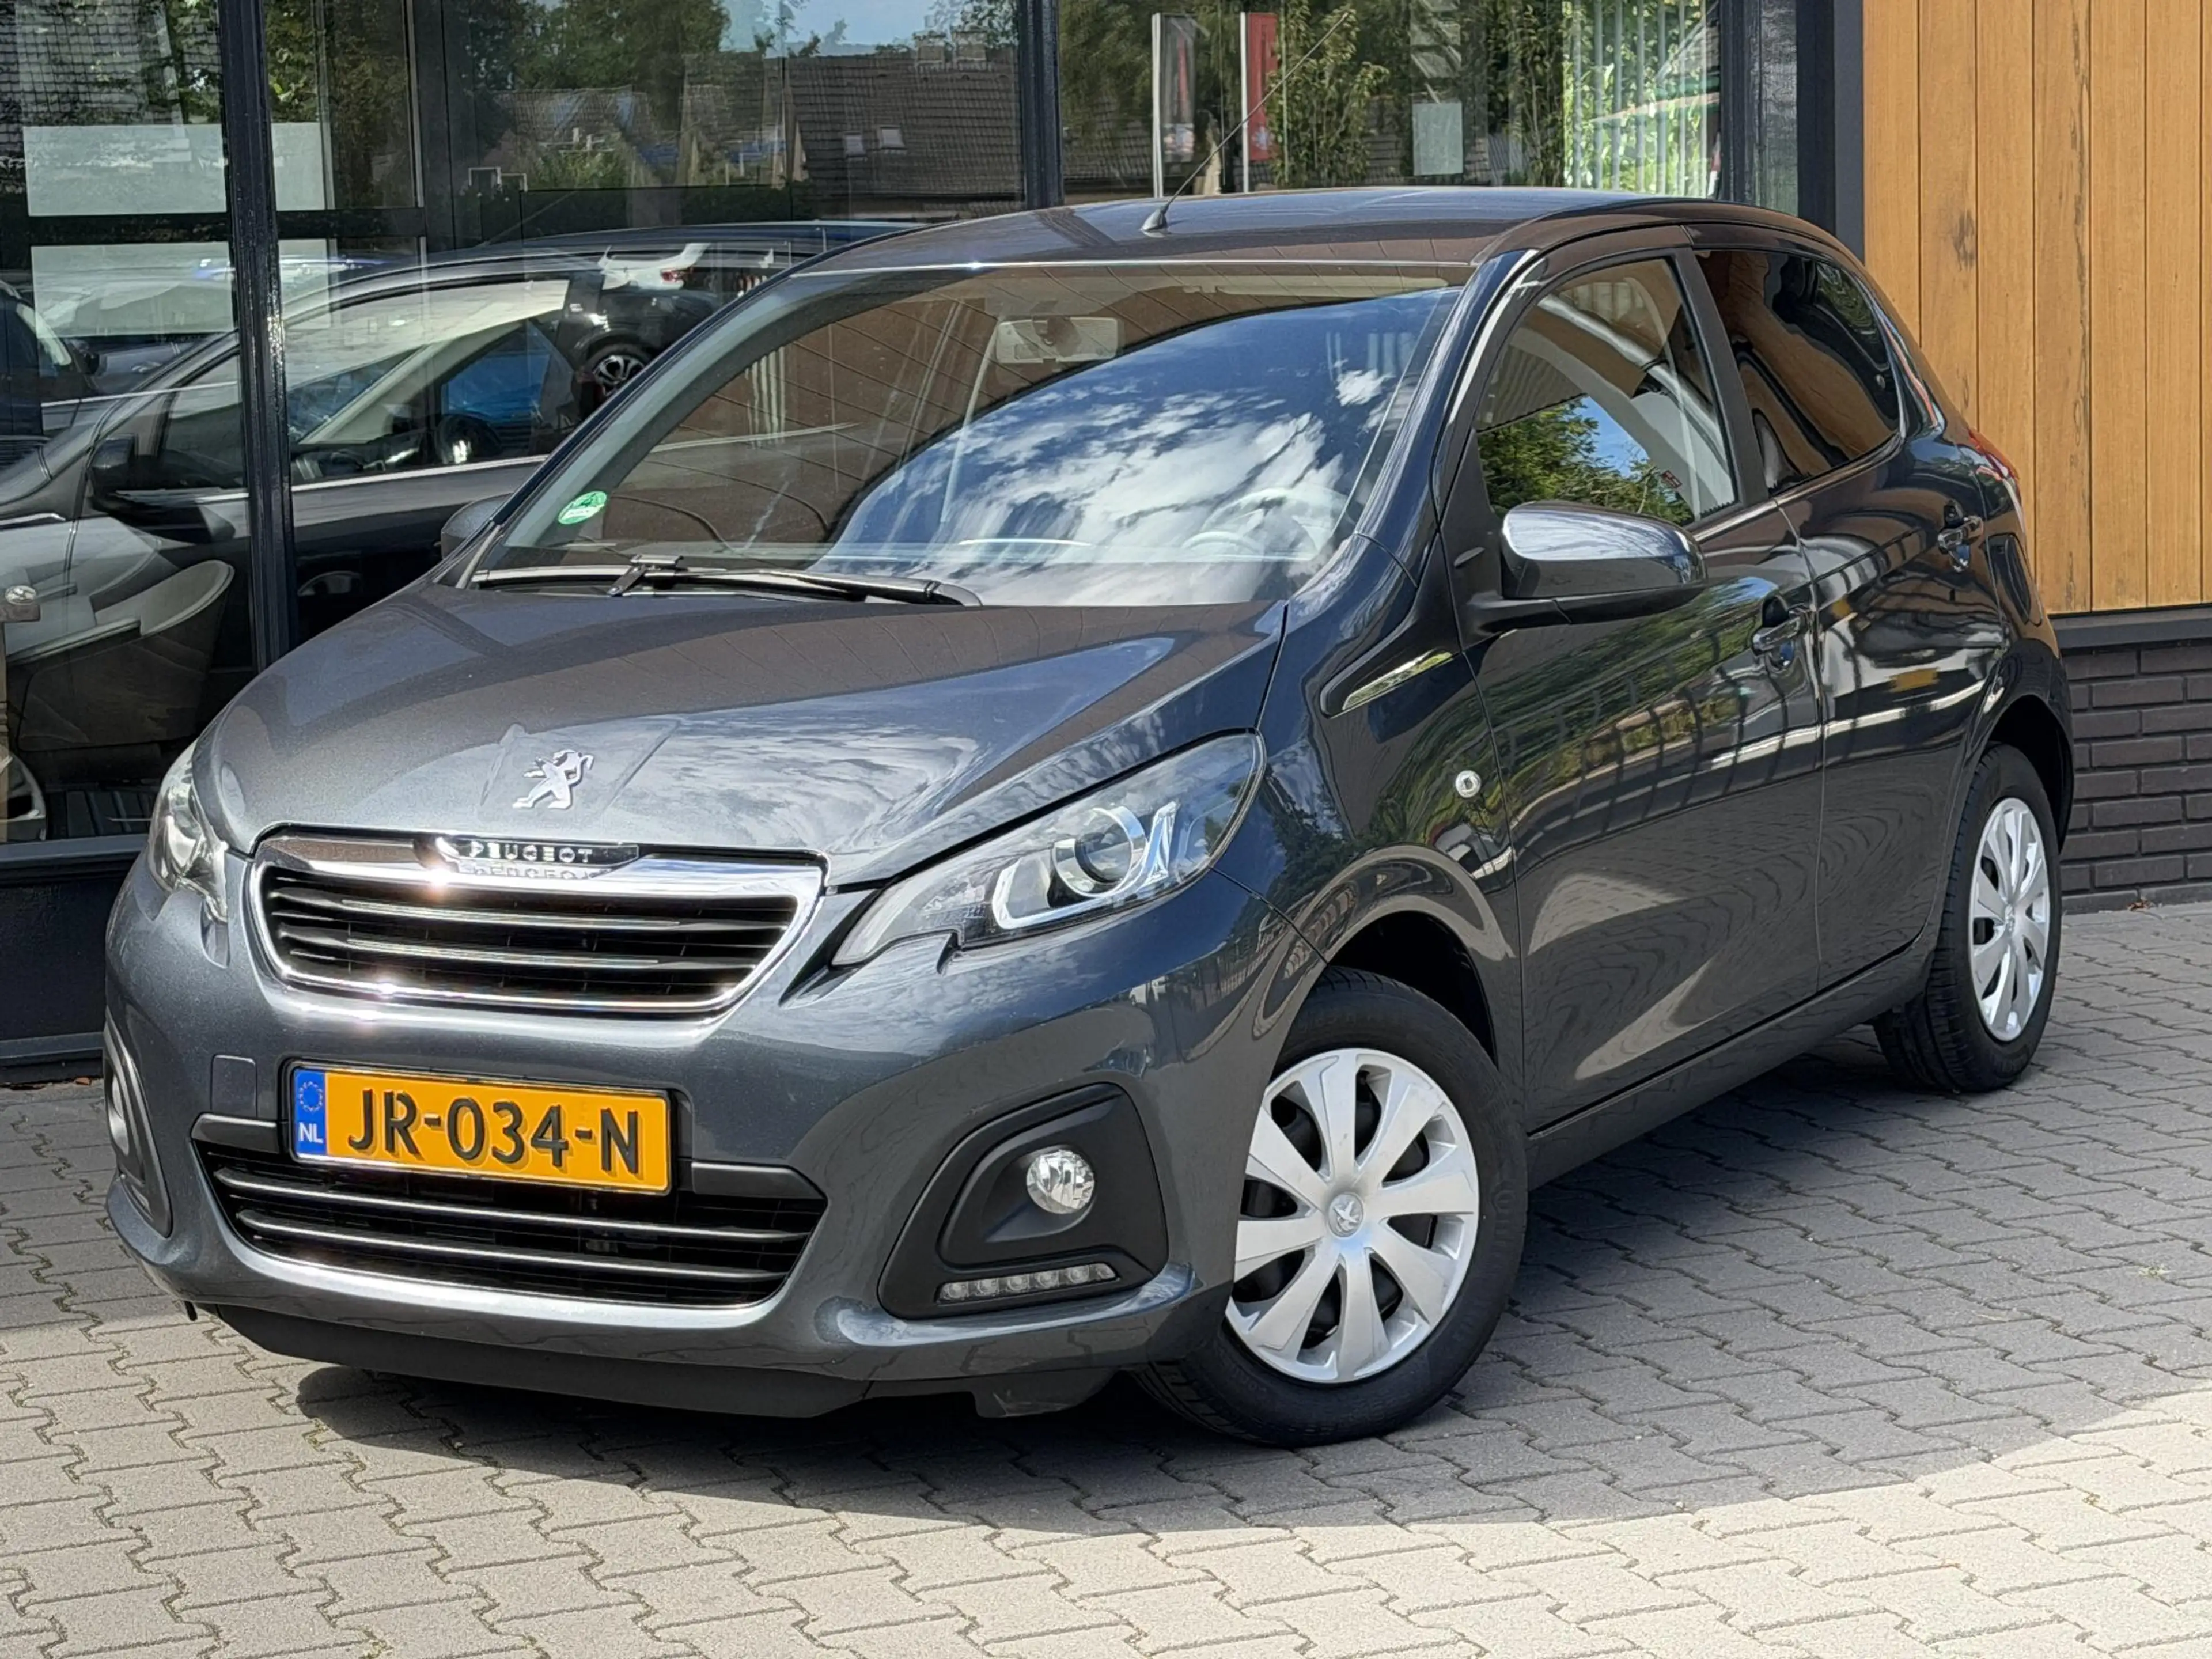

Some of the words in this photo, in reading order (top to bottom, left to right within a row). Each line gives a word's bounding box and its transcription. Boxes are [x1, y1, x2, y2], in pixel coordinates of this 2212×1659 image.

[469, 840, 593, 863] PEUGEOT
[298, 1122, 324, 1143] NL
[347, 1088, 639, 1175] JR-034-N
